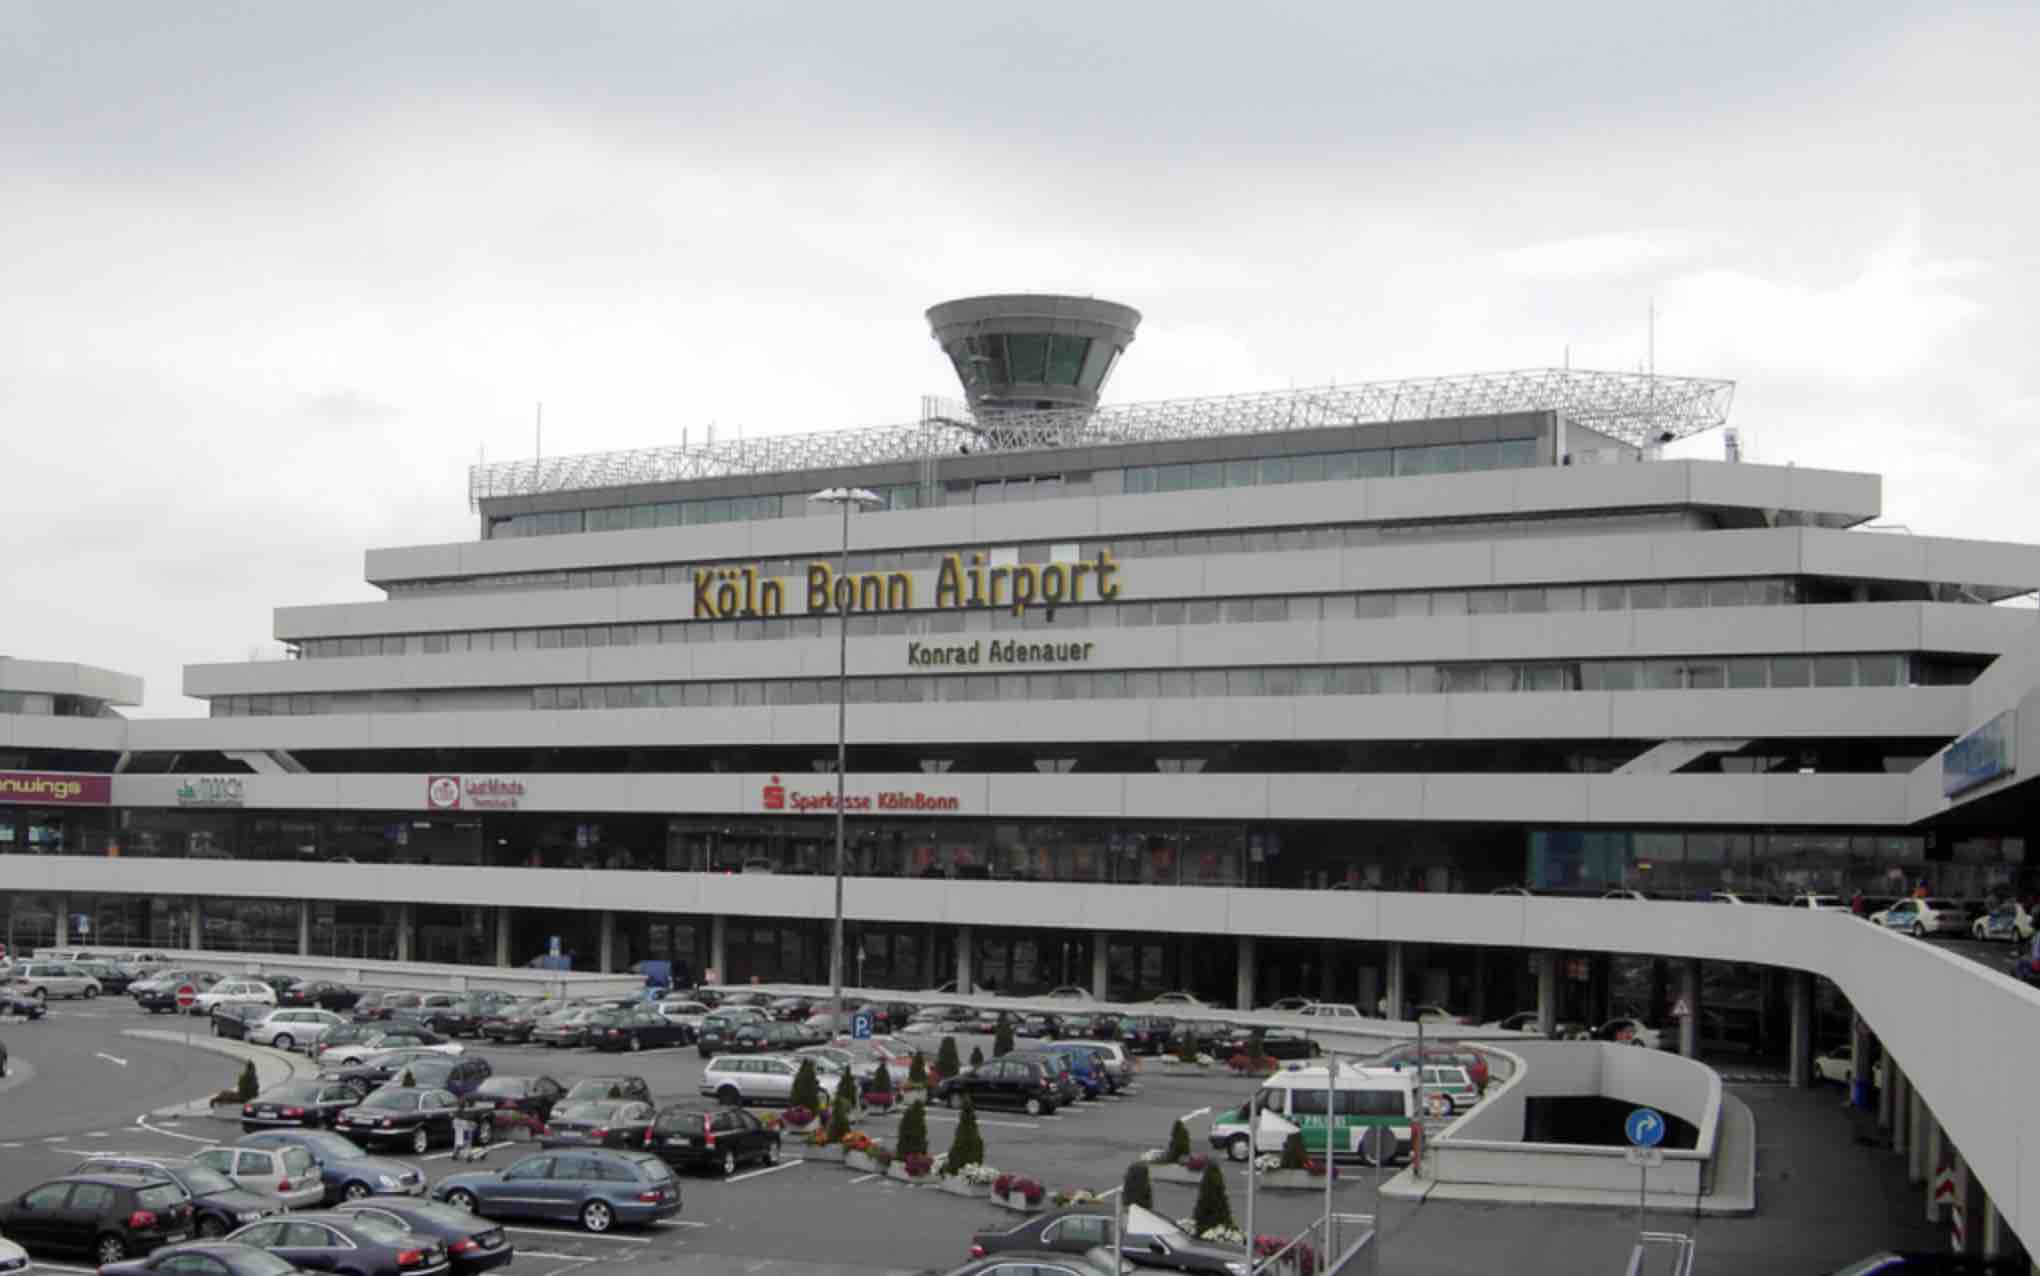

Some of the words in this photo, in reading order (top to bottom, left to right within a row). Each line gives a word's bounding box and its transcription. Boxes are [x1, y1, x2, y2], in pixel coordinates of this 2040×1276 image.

[694, 564, 785, 617] Köln
[806, 560, 913, 615] Bonn
[936, 547, 1121, 622] Airport
[907, 640, 981, 665] Konrad
[988, 637, 1094, 663] Adenauer
[877, 791, 960, 810] KölnBonn
[855, 1015, 868, 1037] P
